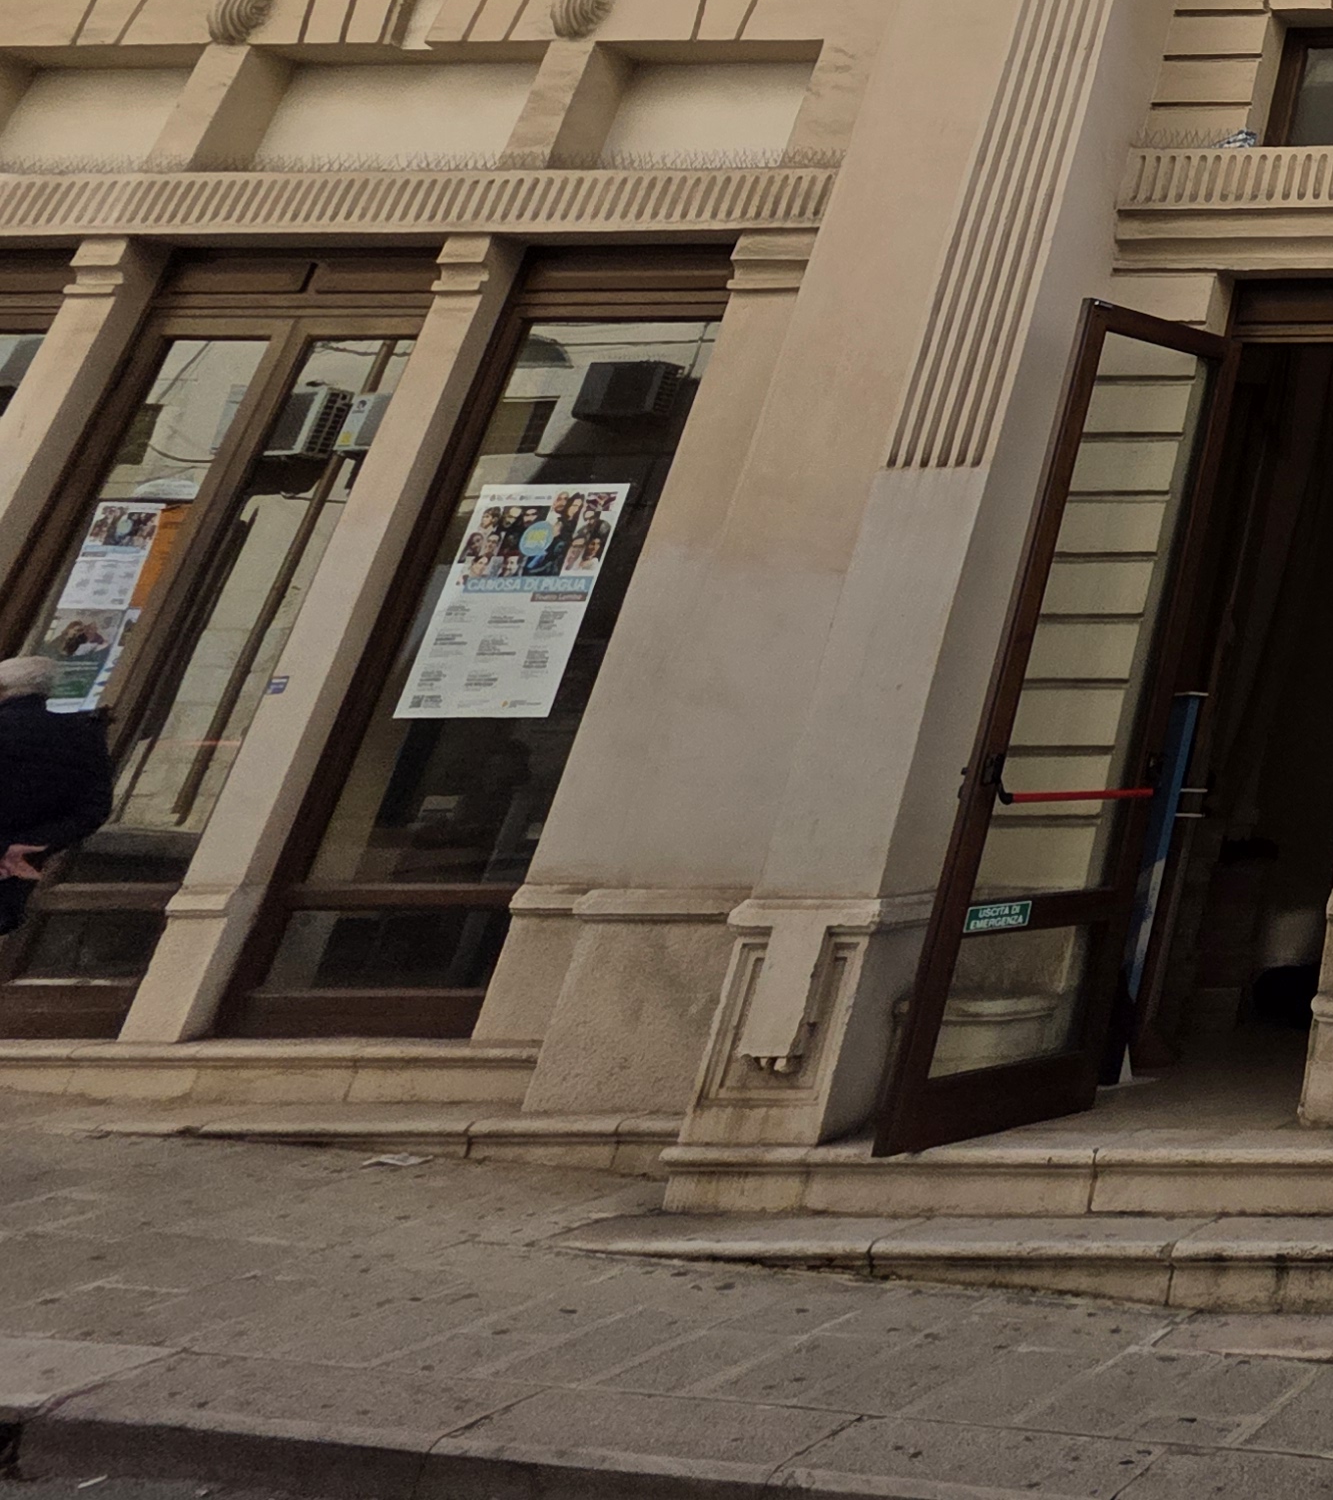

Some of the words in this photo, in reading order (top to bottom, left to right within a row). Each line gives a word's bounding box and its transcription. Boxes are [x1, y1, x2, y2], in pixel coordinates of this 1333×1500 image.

[467, 578, 521, 591] CANOSA
[523, 578, 540, 591] DI
[540, 578, 587, 591] PUGLIA
[978, 906, 1009, 918] USCITA
[1011, 905, 1021, 915] DI
[970, 915, 1023, 930] EMERGENZA
